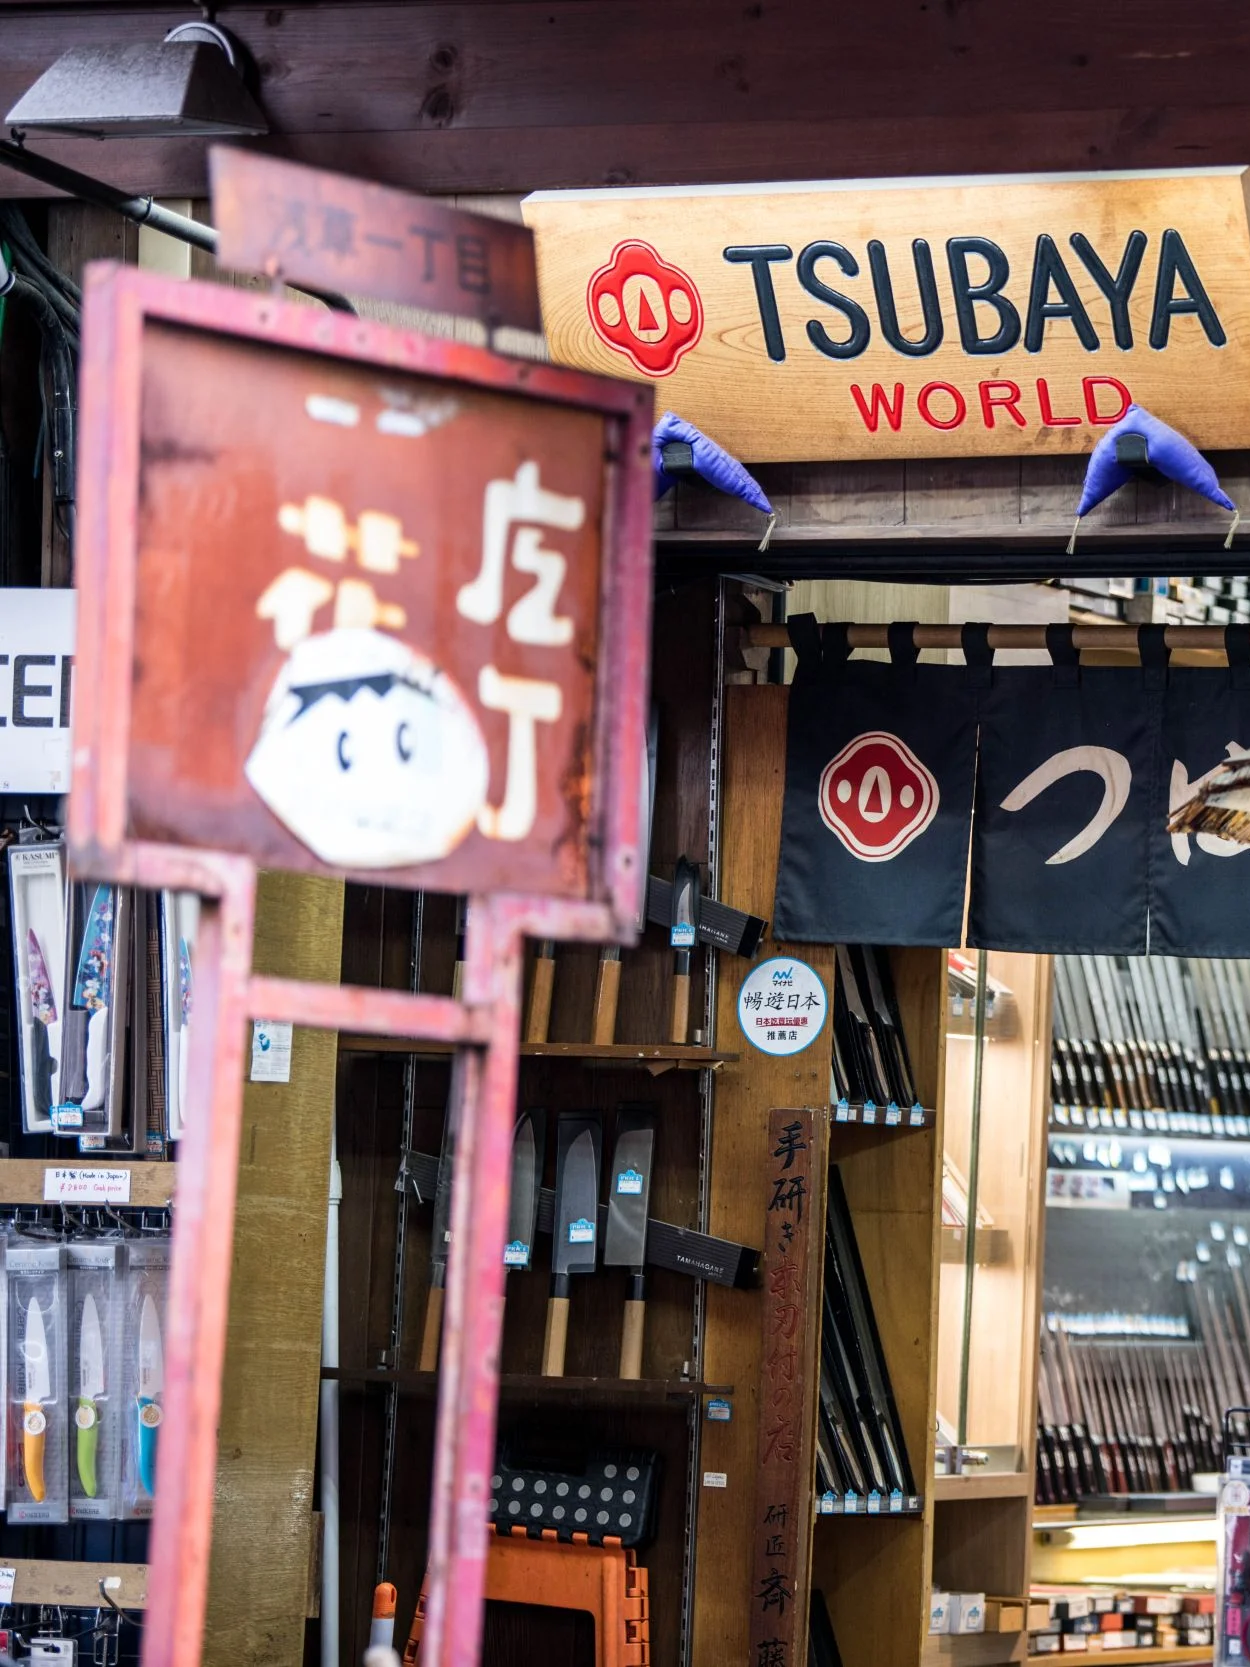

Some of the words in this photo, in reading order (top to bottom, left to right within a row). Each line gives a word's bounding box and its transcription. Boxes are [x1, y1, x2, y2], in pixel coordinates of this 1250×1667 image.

[722, 227, 1227, 363] TSUBAYA
[851, 376, 1133, 433] WORLD
[743, 991, 821, 1011] 暢遊日本
[766, 1030, 798, 1041] 推薦店
